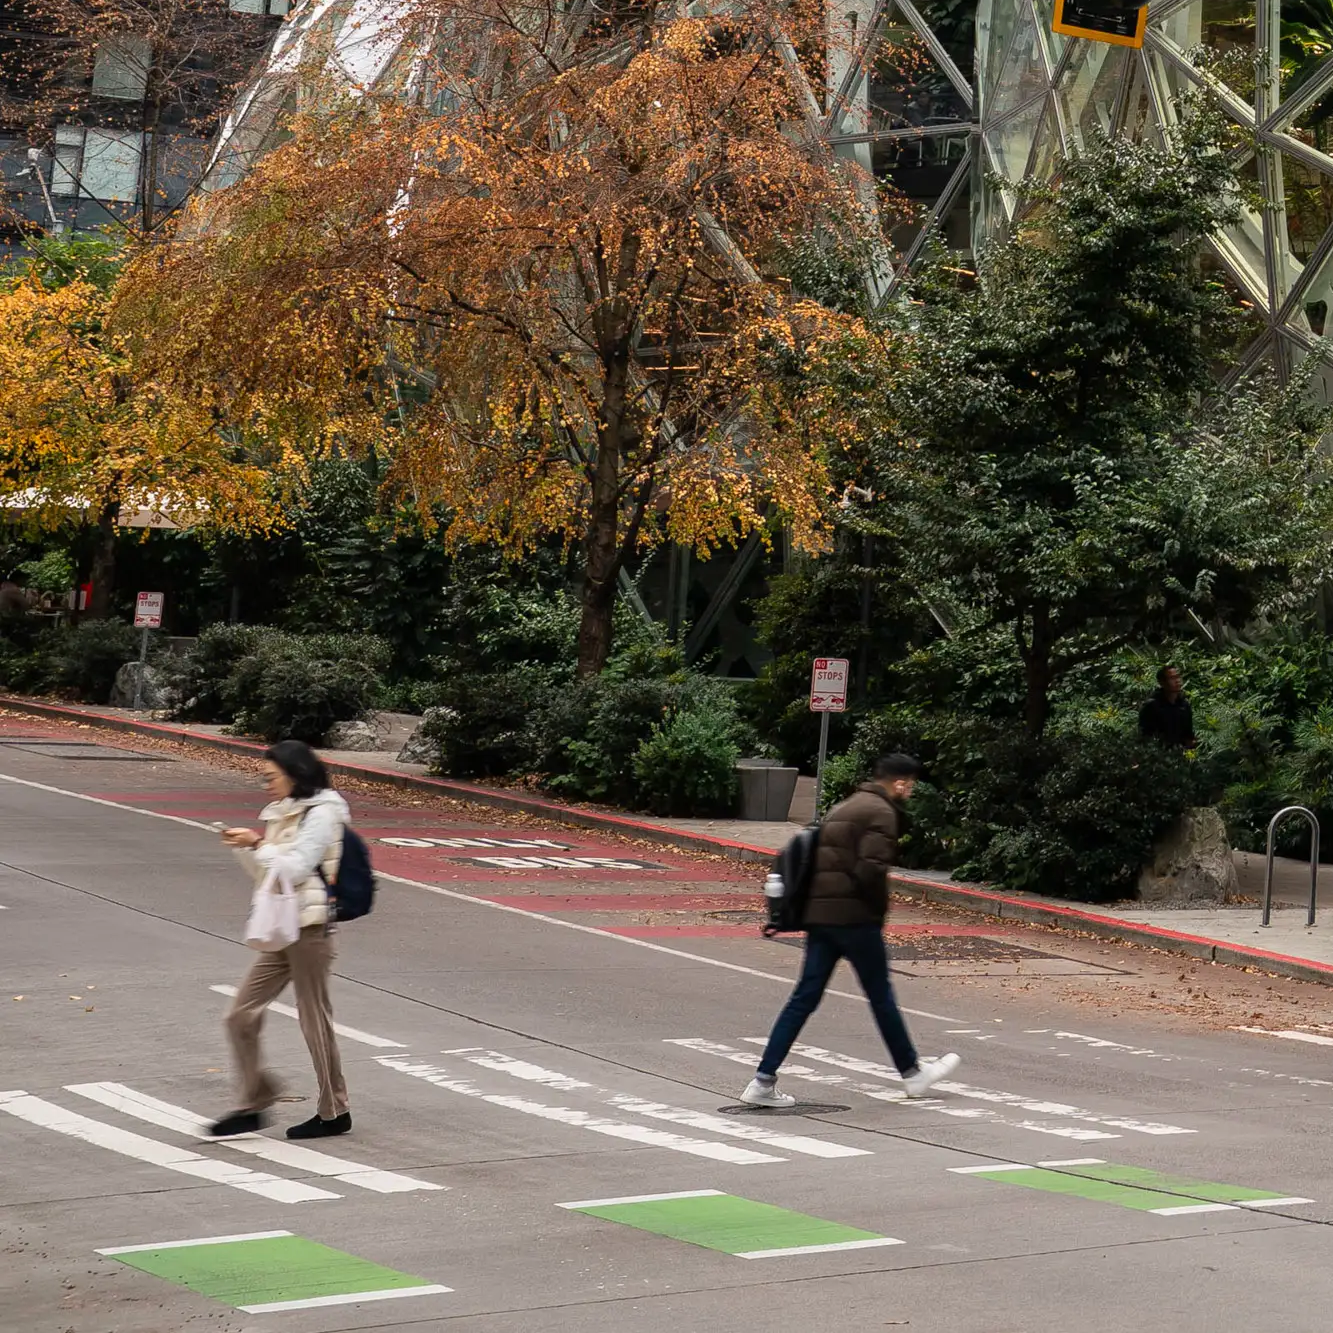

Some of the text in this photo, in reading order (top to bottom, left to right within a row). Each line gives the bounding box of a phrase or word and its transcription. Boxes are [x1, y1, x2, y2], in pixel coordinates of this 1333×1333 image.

[816, 661, 826, 669] NO
[817, 671, 843, 681] STOPS
[380, 837, 570, 849] ONLY
[473, 856, 643, 869] BUS
